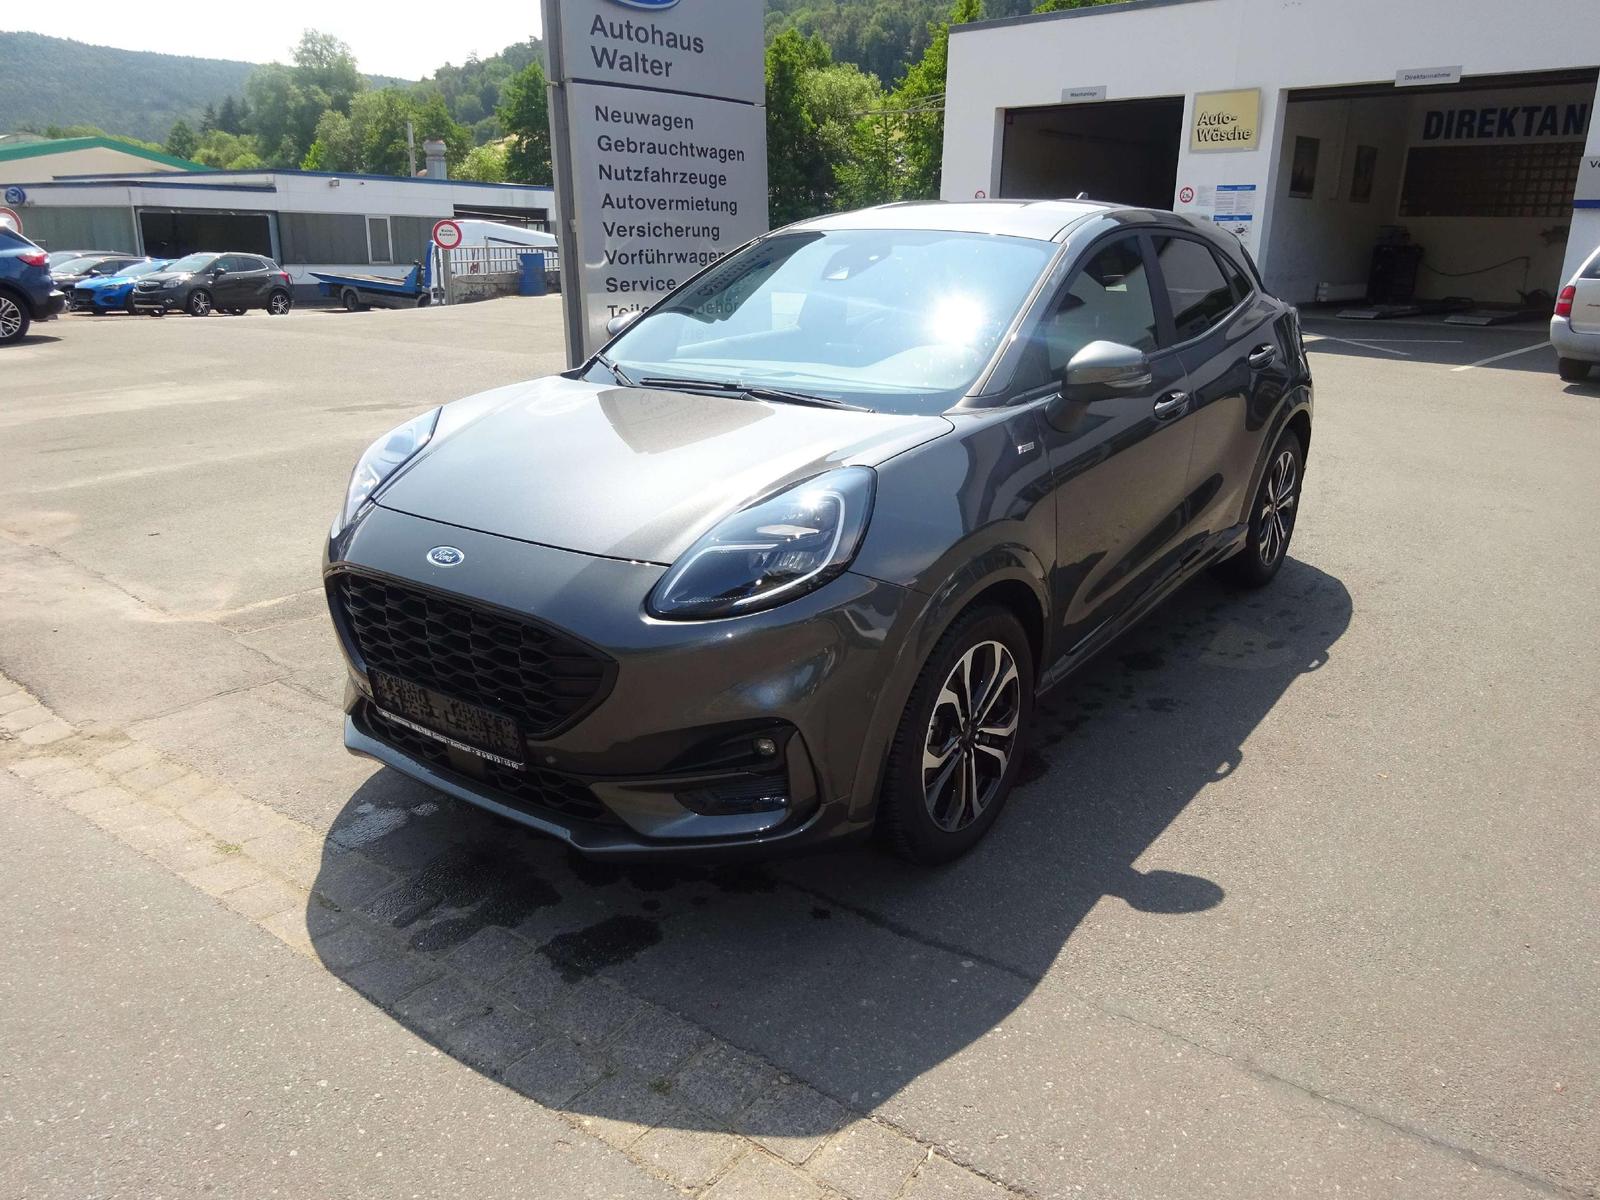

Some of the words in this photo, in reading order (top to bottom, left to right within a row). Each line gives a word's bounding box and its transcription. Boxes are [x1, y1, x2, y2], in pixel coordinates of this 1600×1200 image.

[590, 14, 704, 53] Autohaus
[591, 45, 673, 77] Walter
[594, 105, 694, 131] Neuwagen
[1197, 111, 1237, 126] Auto-
[1422, 103, 1588, 140] DIREKTAN
[1197, 125, 1251, 142] Wäsche
[597, 135, 745, 162] Gebrauchtwagen
[599, 164, 727, 189] Nutzfahrzeuge
[601, 193, 738, 216] Autovermietung
[603, 222, 720, 241] Versicherung
[606, 277, 676, 293] Service
